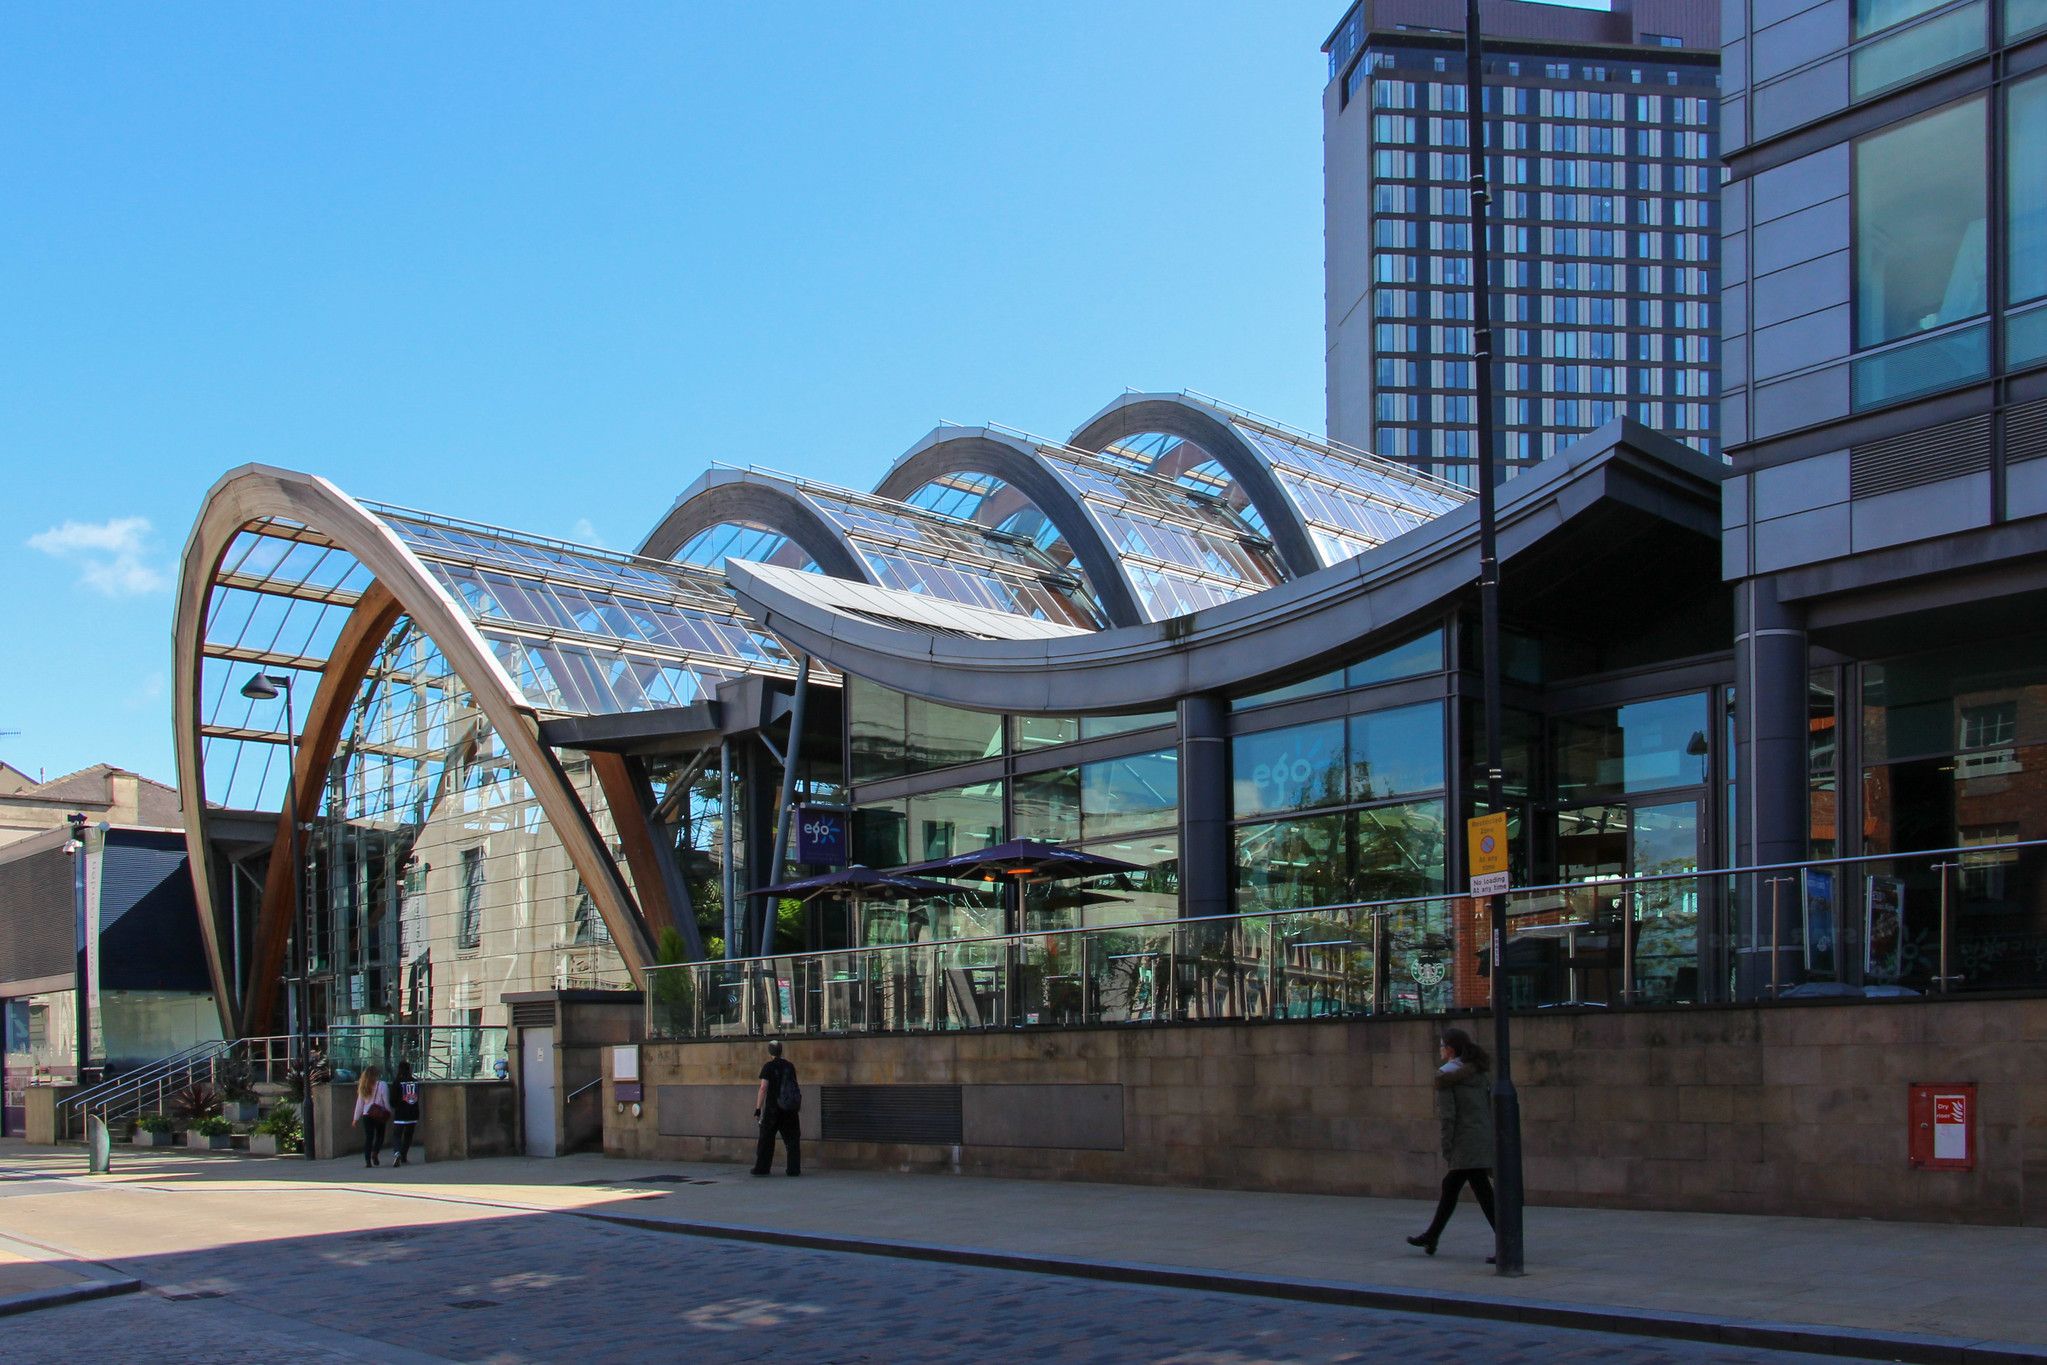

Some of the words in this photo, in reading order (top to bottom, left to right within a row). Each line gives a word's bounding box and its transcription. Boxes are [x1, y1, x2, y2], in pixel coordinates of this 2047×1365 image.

[1253, 752, 1312, 807] ego
[804, 821, 829, 843] ego
[1484, 876, 1505, 884] loading
